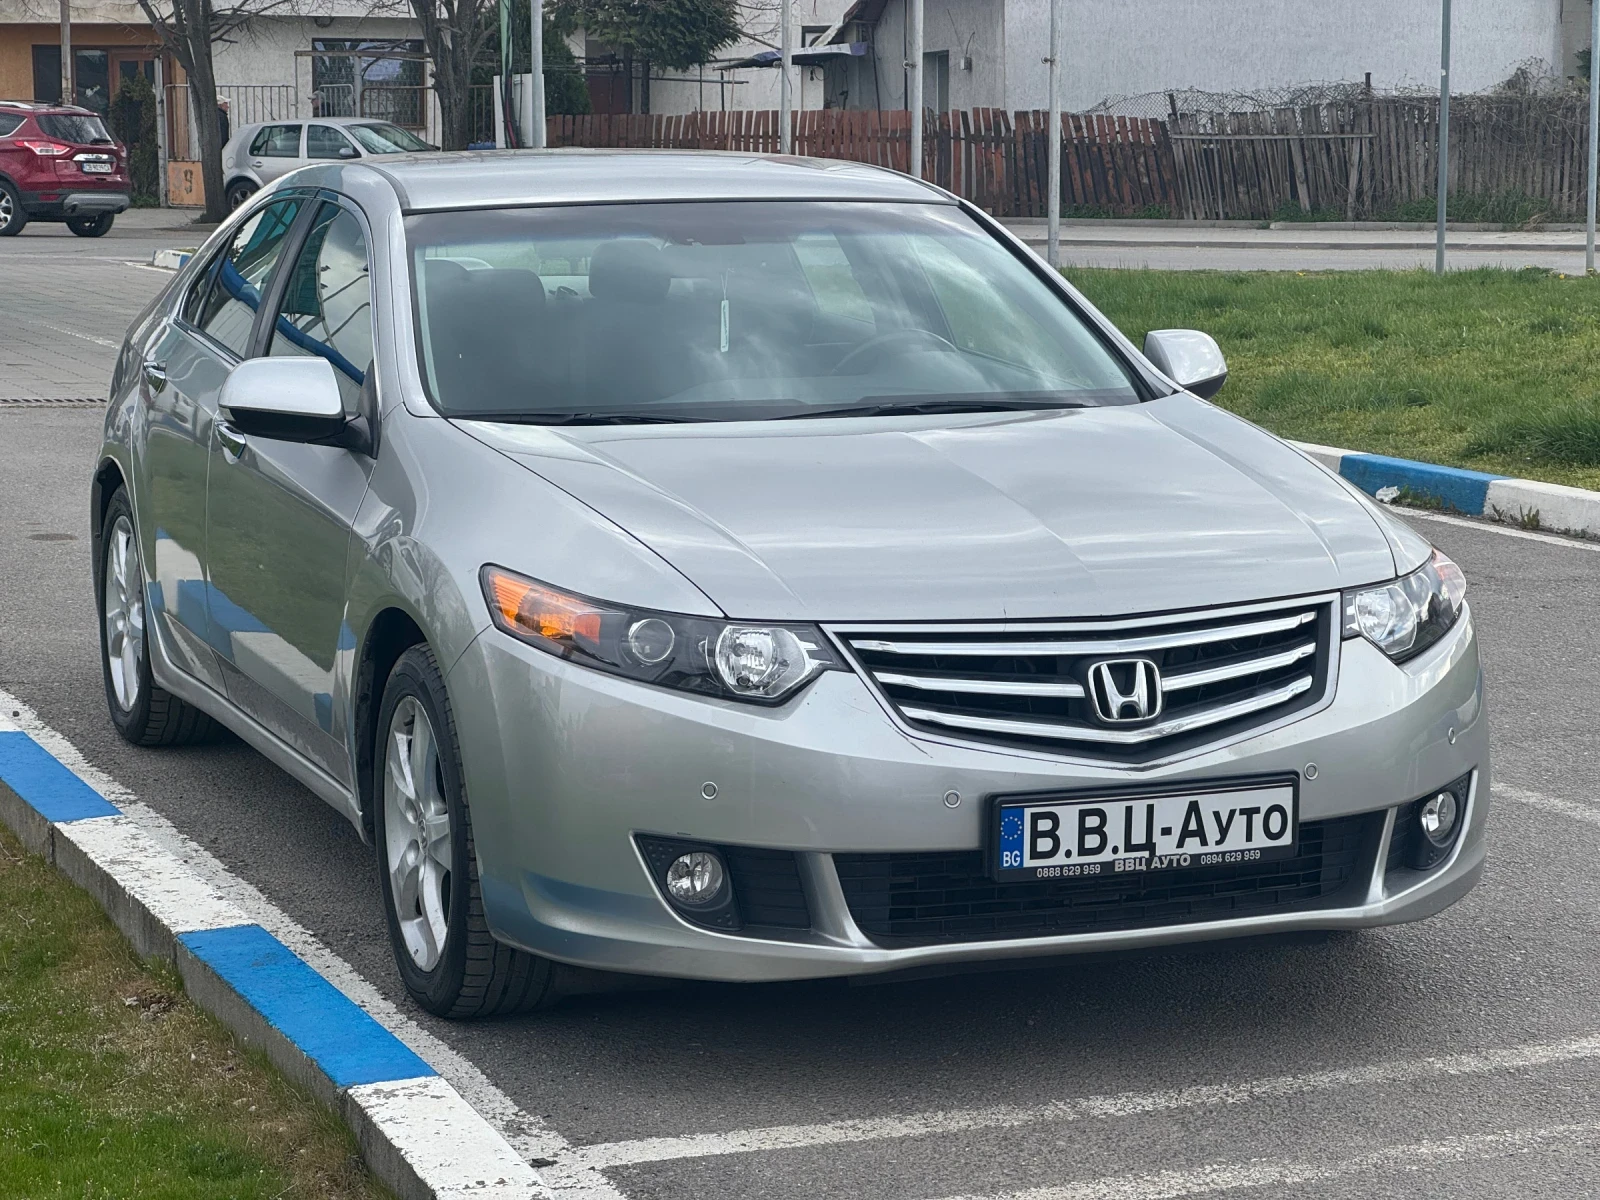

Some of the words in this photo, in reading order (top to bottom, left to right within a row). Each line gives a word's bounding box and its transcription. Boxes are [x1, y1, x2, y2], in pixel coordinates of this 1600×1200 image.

[1003, 850, 1021, 867] BG
[1114, 858, 1147, 872] ВВЦ
[1150, 854, 1191, 869] АУТО
[1200, 854, 1222, 865] 0894
[1225, 852, 1242, 863] 629
[1244, 849, 1261, 861] 959
[1036, 867, 1061, 878] 0888
[1062, 865, 1081, 876] 629
[1083, 864, 1101, 875] 959
